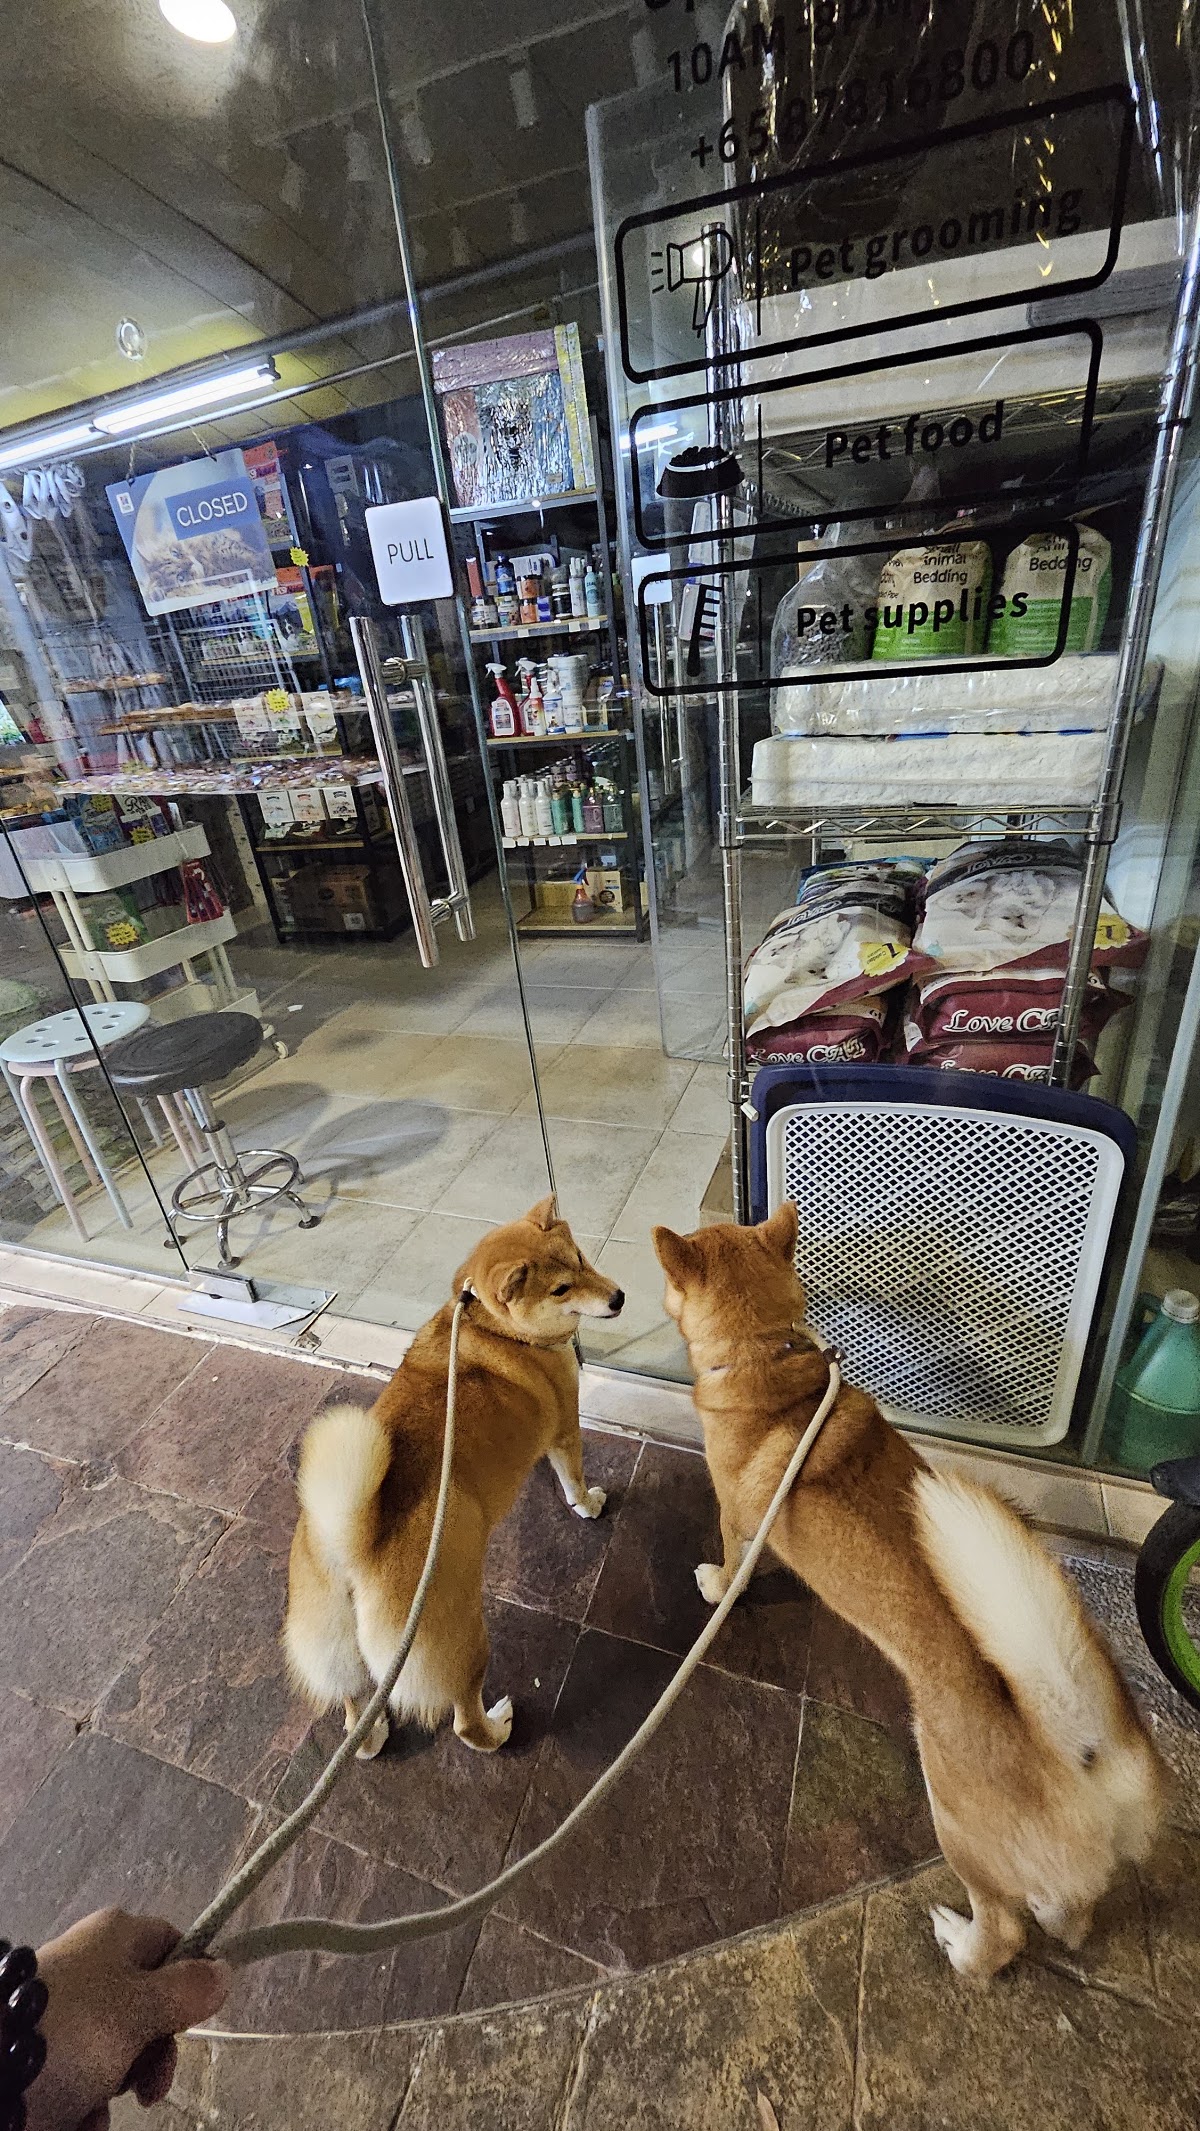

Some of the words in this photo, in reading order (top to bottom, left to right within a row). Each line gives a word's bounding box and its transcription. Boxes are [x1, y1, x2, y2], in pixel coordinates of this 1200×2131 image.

[790, 237, 855, 287] Pet
[865, 188, 1084, 280] grooming
[826, 424, 892, 468] Pet
[903, 399, 1004, 456] food
[176, 492, 248, 527] CLOSED
[387, 538, 434, 564] PULL
[913, 569, 968, 585] Bedding
[797, 604, 854, 638] Pet
[863, 586, 1029, 634] supplies
[942, 1009, 1014, 1032] Love
